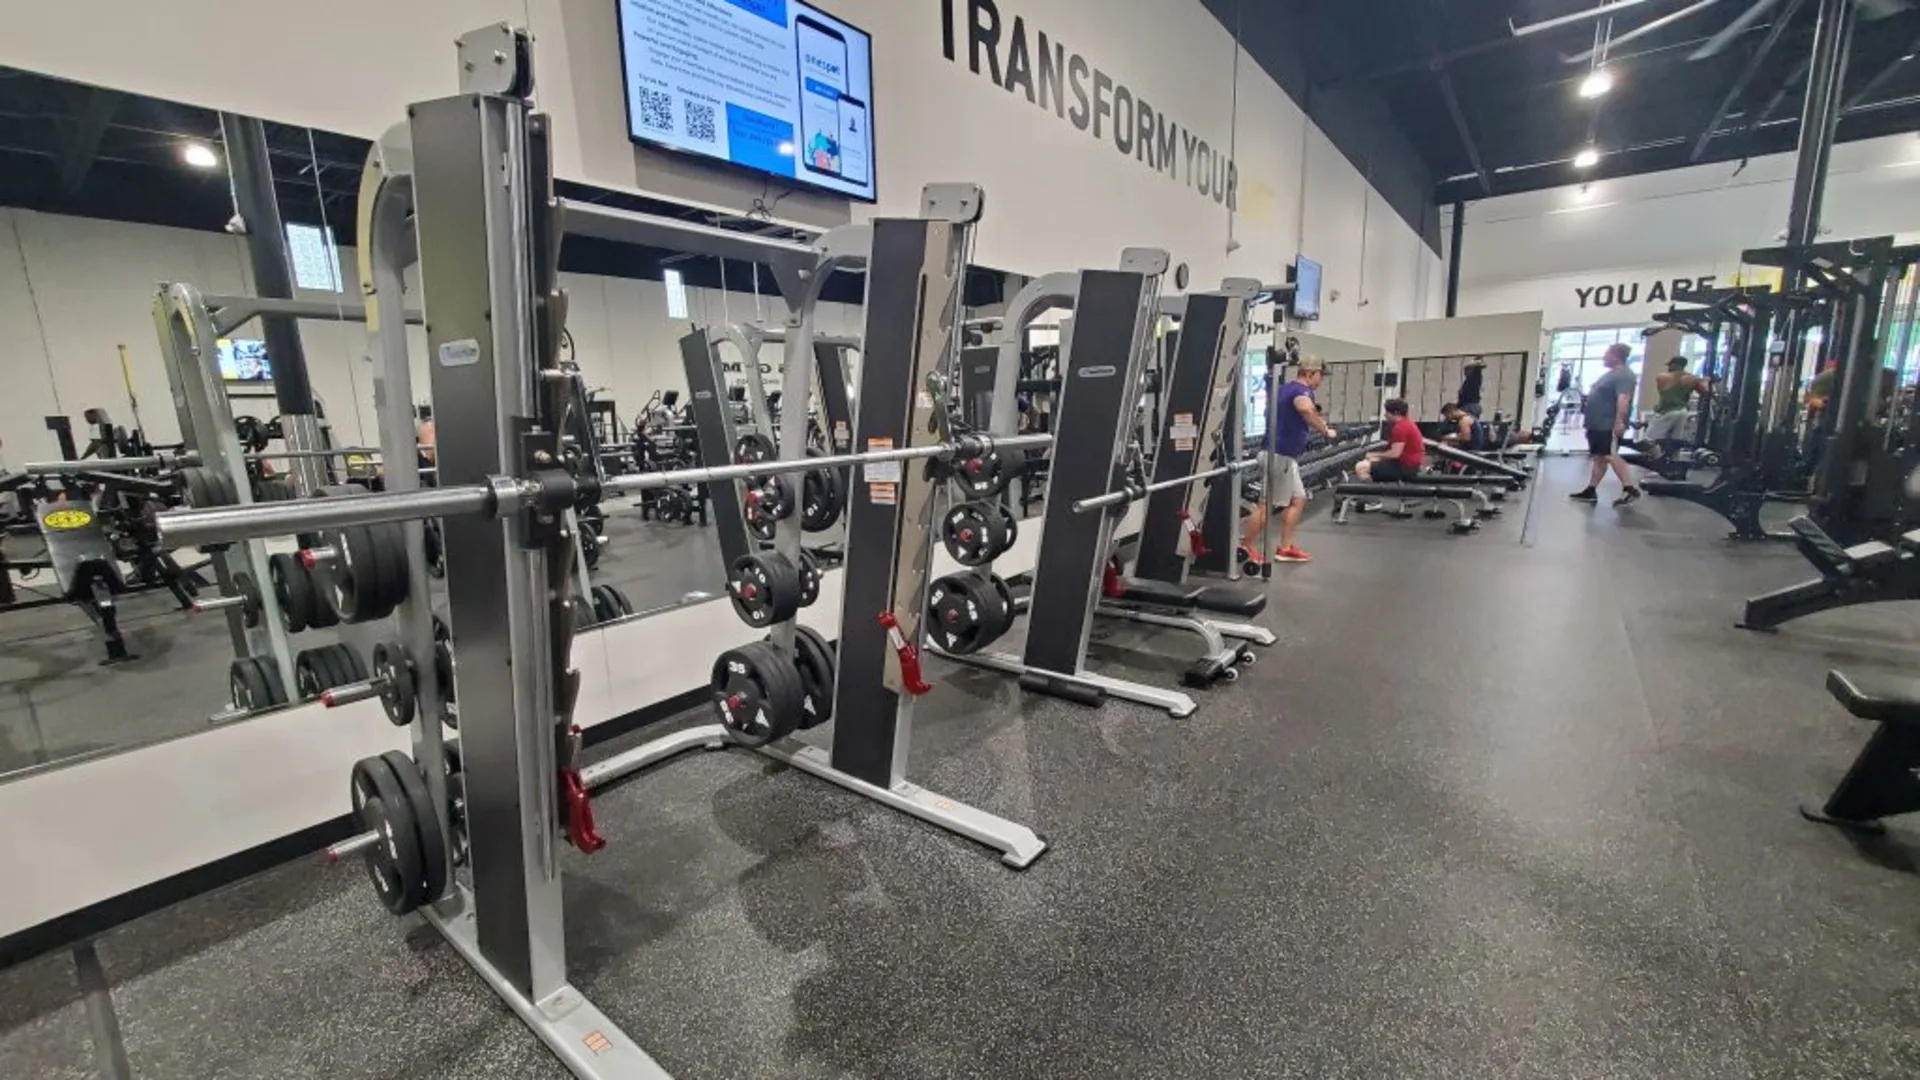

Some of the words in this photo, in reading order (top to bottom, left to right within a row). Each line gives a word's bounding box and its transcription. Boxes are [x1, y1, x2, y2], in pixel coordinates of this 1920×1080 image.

[940, 0, 1177, 180] TRANSFORM
[1182, 127, 1239, 212] YOUR
[1575, 282, 1639, 308] YOU
[1646, 275, 1717, 303] ARE
